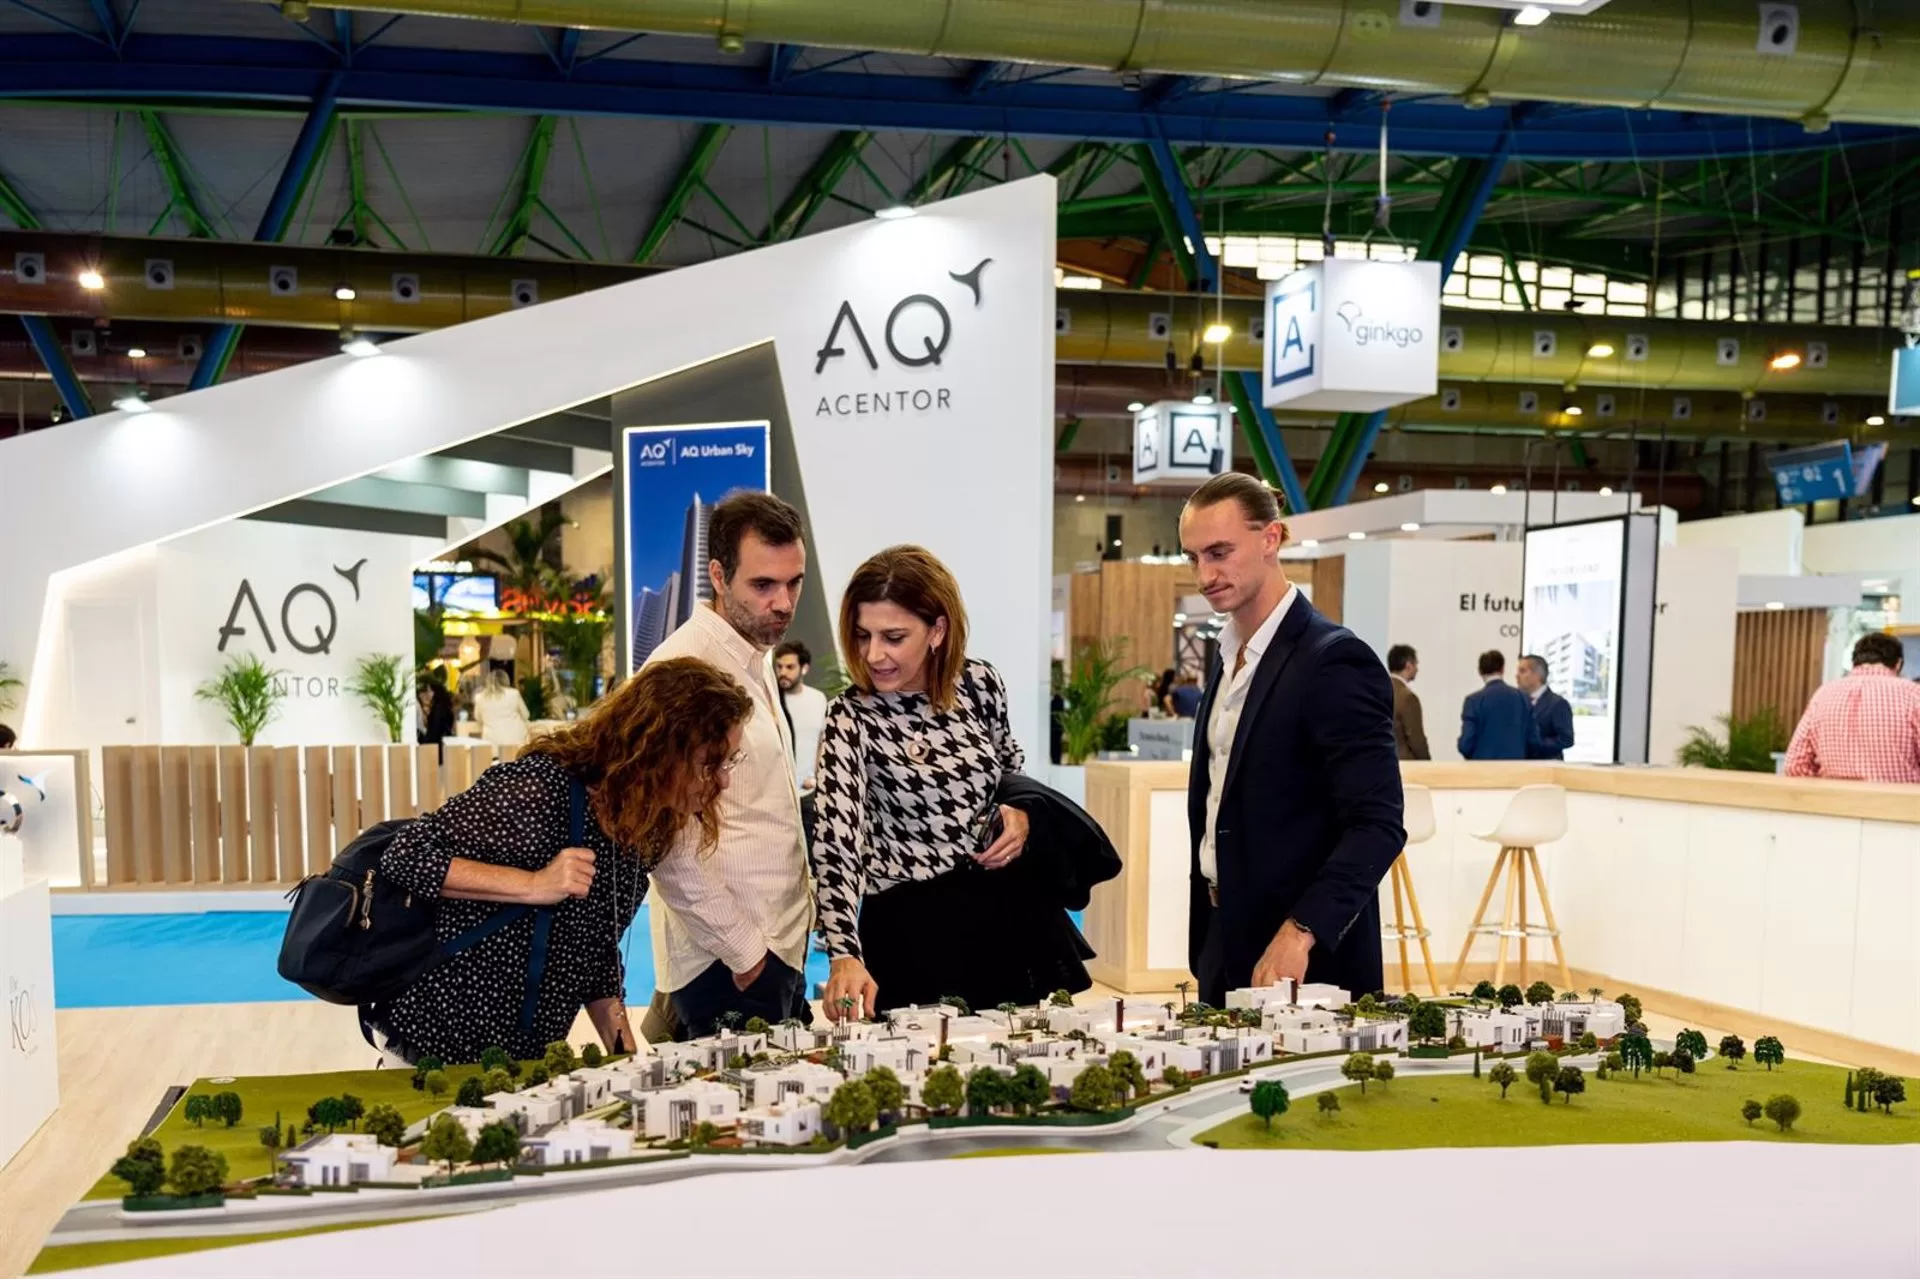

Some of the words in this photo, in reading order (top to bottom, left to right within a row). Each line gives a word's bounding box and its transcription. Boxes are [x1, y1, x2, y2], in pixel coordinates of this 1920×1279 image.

[815, 294, 952, 374] AQ
[1282, 315, 1304, 359] A
[1355, 324, 1423, 348] ginkgo
[815, 388, 951, 417] ACENTOR
[640, 443, 666, 459] AQ
[680, 446, 699, 458] AQ
[701, 445, 734, 457] Urban
[734, 443, 755, 458] Sky
[1183, 428, 1207, 453] A
[1460, 593, 1476, 611] El
[1484, 592, 1523, 612] futu
[217, 578, 337, 655] AQ
[1500, 624, 1520, 638] co
